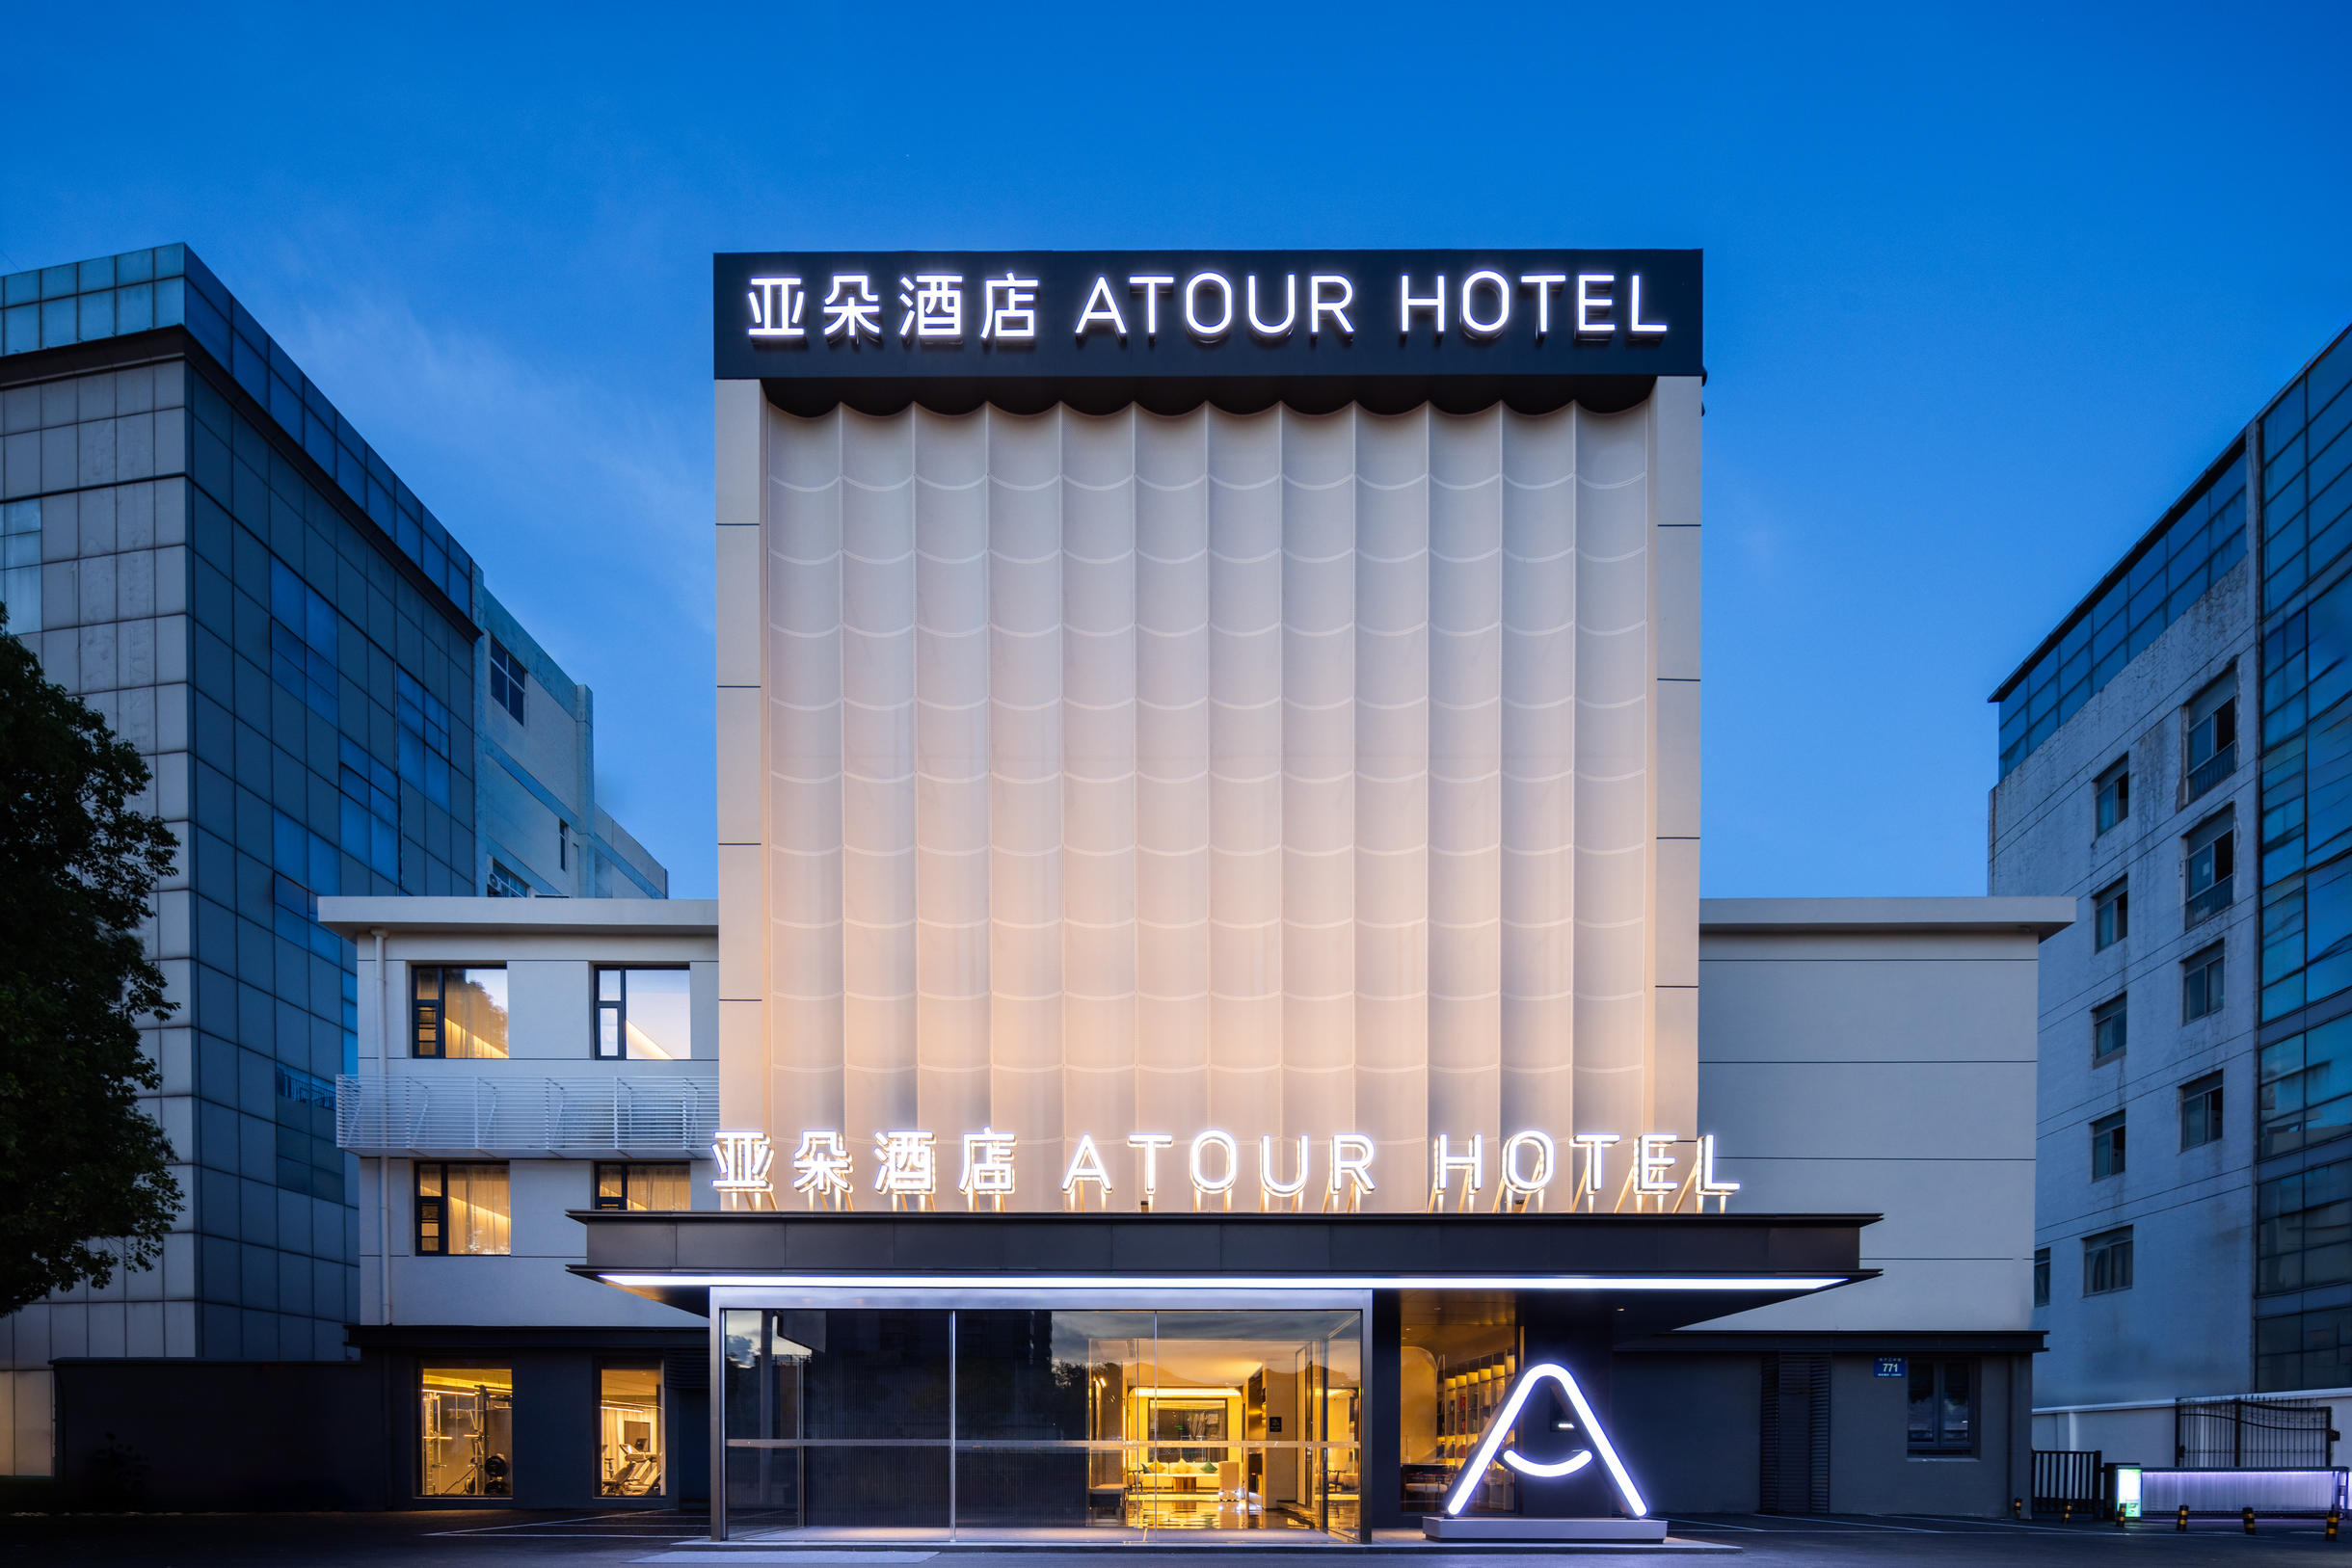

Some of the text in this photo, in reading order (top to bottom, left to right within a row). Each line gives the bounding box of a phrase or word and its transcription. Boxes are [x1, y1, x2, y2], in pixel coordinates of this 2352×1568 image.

[747, 270, 1669, 340] 亚朵酒店 ATOUR HOTEL
[711, 1127, 1741, 1196] 亚朵酒店 ATOUR HOTEL
[1883, 1363, 1898, 1372] 771
